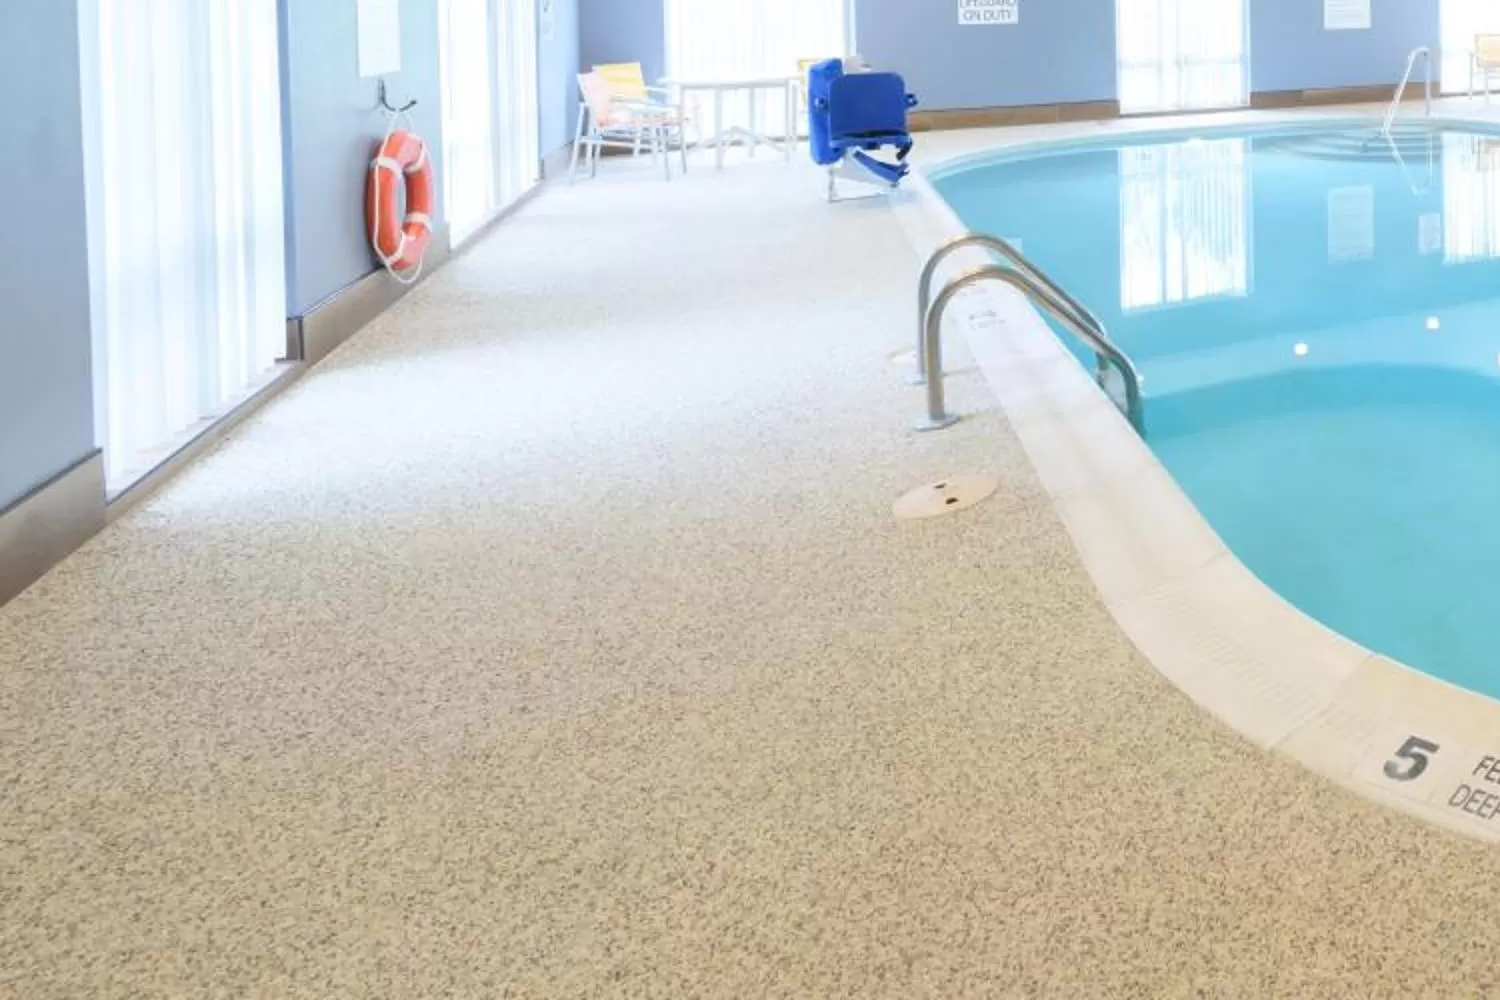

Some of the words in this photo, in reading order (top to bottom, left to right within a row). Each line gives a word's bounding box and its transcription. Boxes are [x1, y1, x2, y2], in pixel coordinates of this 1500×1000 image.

[962, 9, 981, 21] ON
[983, 9, 1011, 21] DUTY
[1383, 735, 1440, 781] 5
